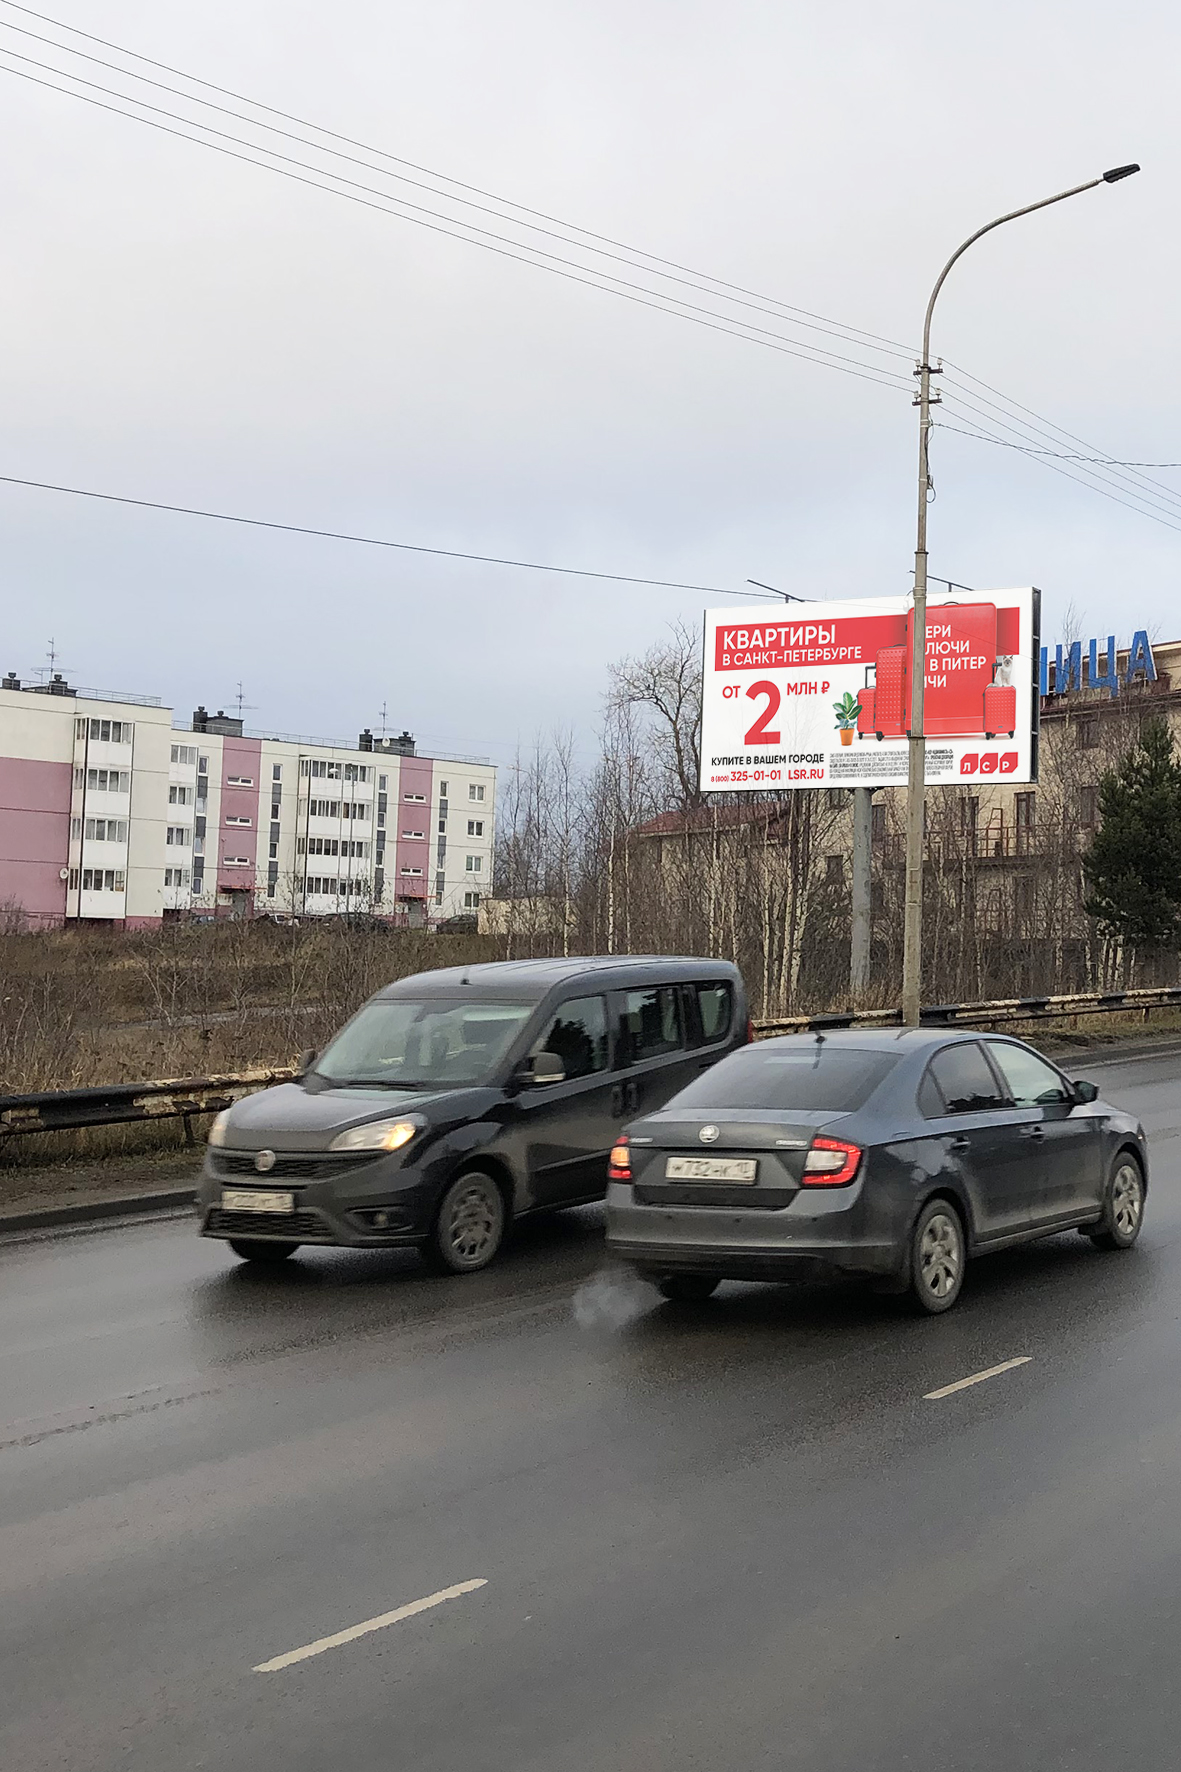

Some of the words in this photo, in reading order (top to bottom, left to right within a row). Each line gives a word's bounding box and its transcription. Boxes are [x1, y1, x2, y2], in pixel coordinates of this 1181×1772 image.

[723, 624, 836, 650] КВАРТИРЫ
[925, 624, 951, 639] ЕРИ
[722, 653, 731, 666] В
[733, 646, 862, 666] САНКТ-ПЕТЕРБУРГЕ
[924, 640, 970, 656] ЛЮЧИ
[929, 658, 939, 672] В
[942, 656, 987, 671] ПИТЕР
[924, 674, 947, 689] ЧИ
[722, 685, 741, 699] ОТ
[744, 680, 781, 746] 2
[787, 681, 818, 696] МЛН
[711, 756, 744, 766] КУПИТЕ
[746, 755, 752, 765] В
[753, 754, 786, 765] ВАШЕМ
[788, 753, 825, 764] ГОРОДЕ
[730, 769, 781, 782] 325-01-01
[788, 768, 825, 780] LSR.RU
